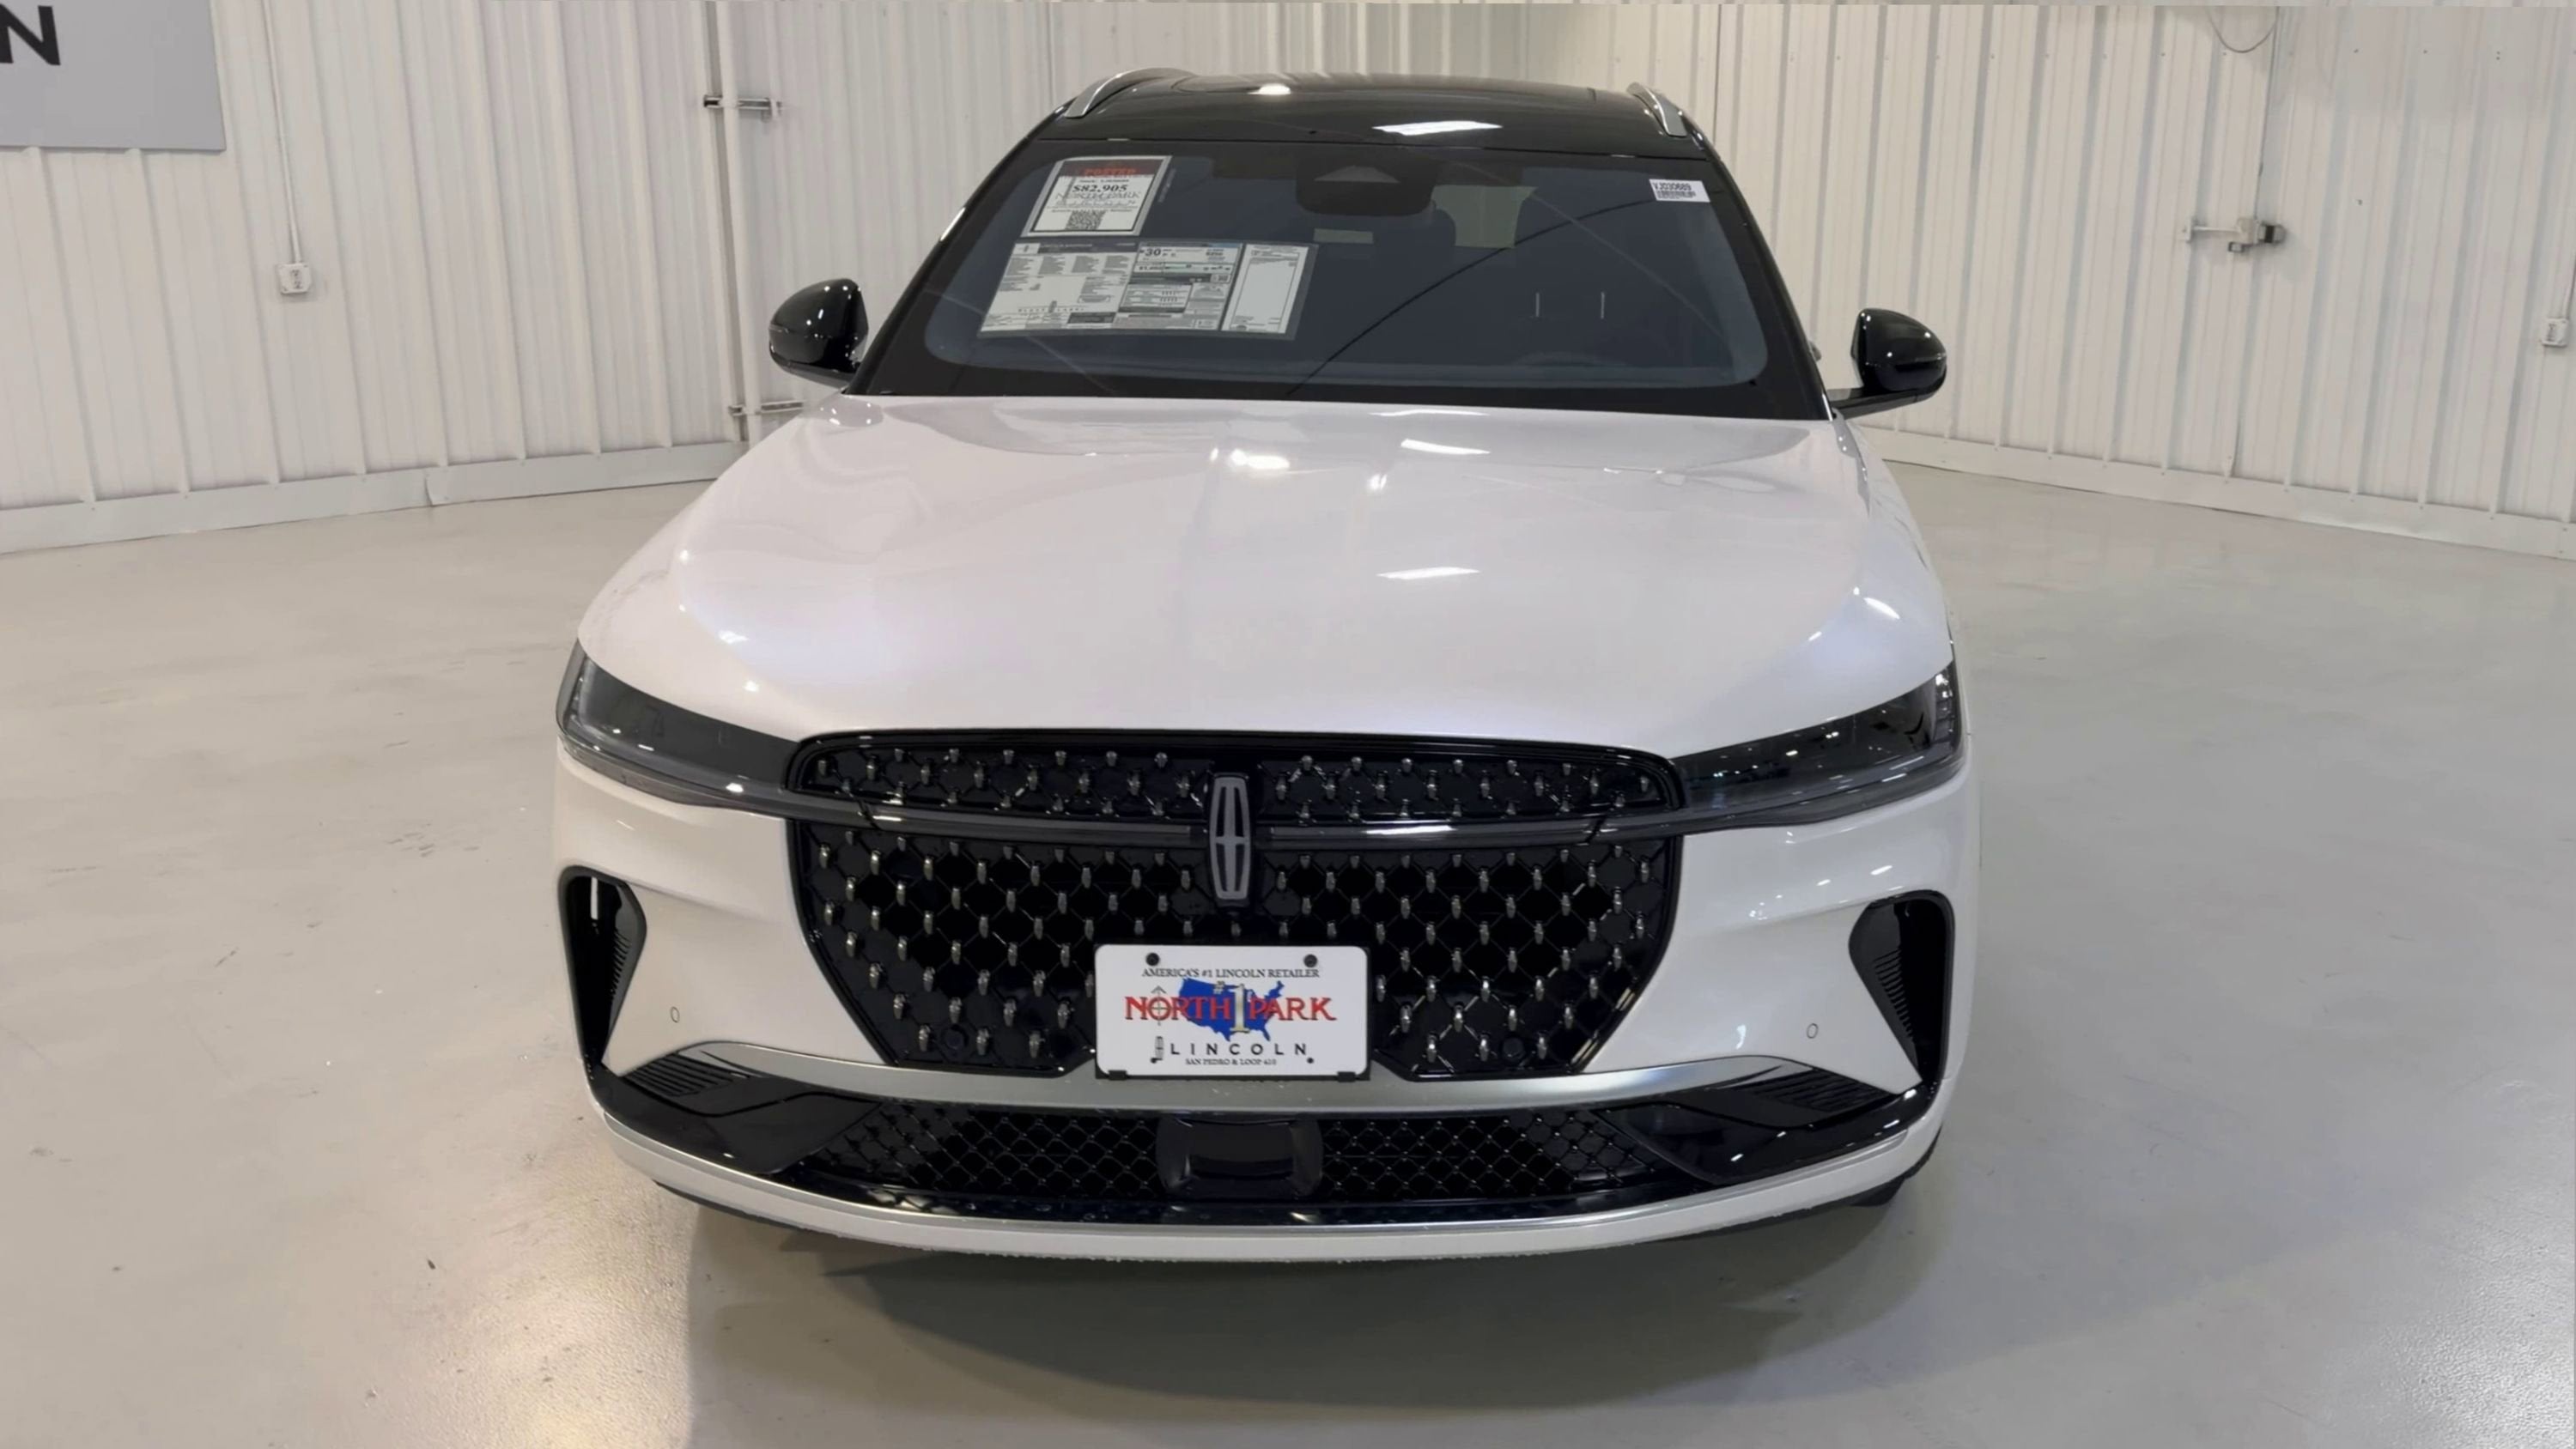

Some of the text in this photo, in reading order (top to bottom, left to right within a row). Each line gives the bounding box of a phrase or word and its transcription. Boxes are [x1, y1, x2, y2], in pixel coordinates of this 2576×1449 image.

[1141, 968, 1320, 978] AMERICA'S #1 LINCOLN RETAILER
[1125, 996, 1337, 1021] NORTH PARK
[1170, 1042, 1307, 1056] LINCOLN
